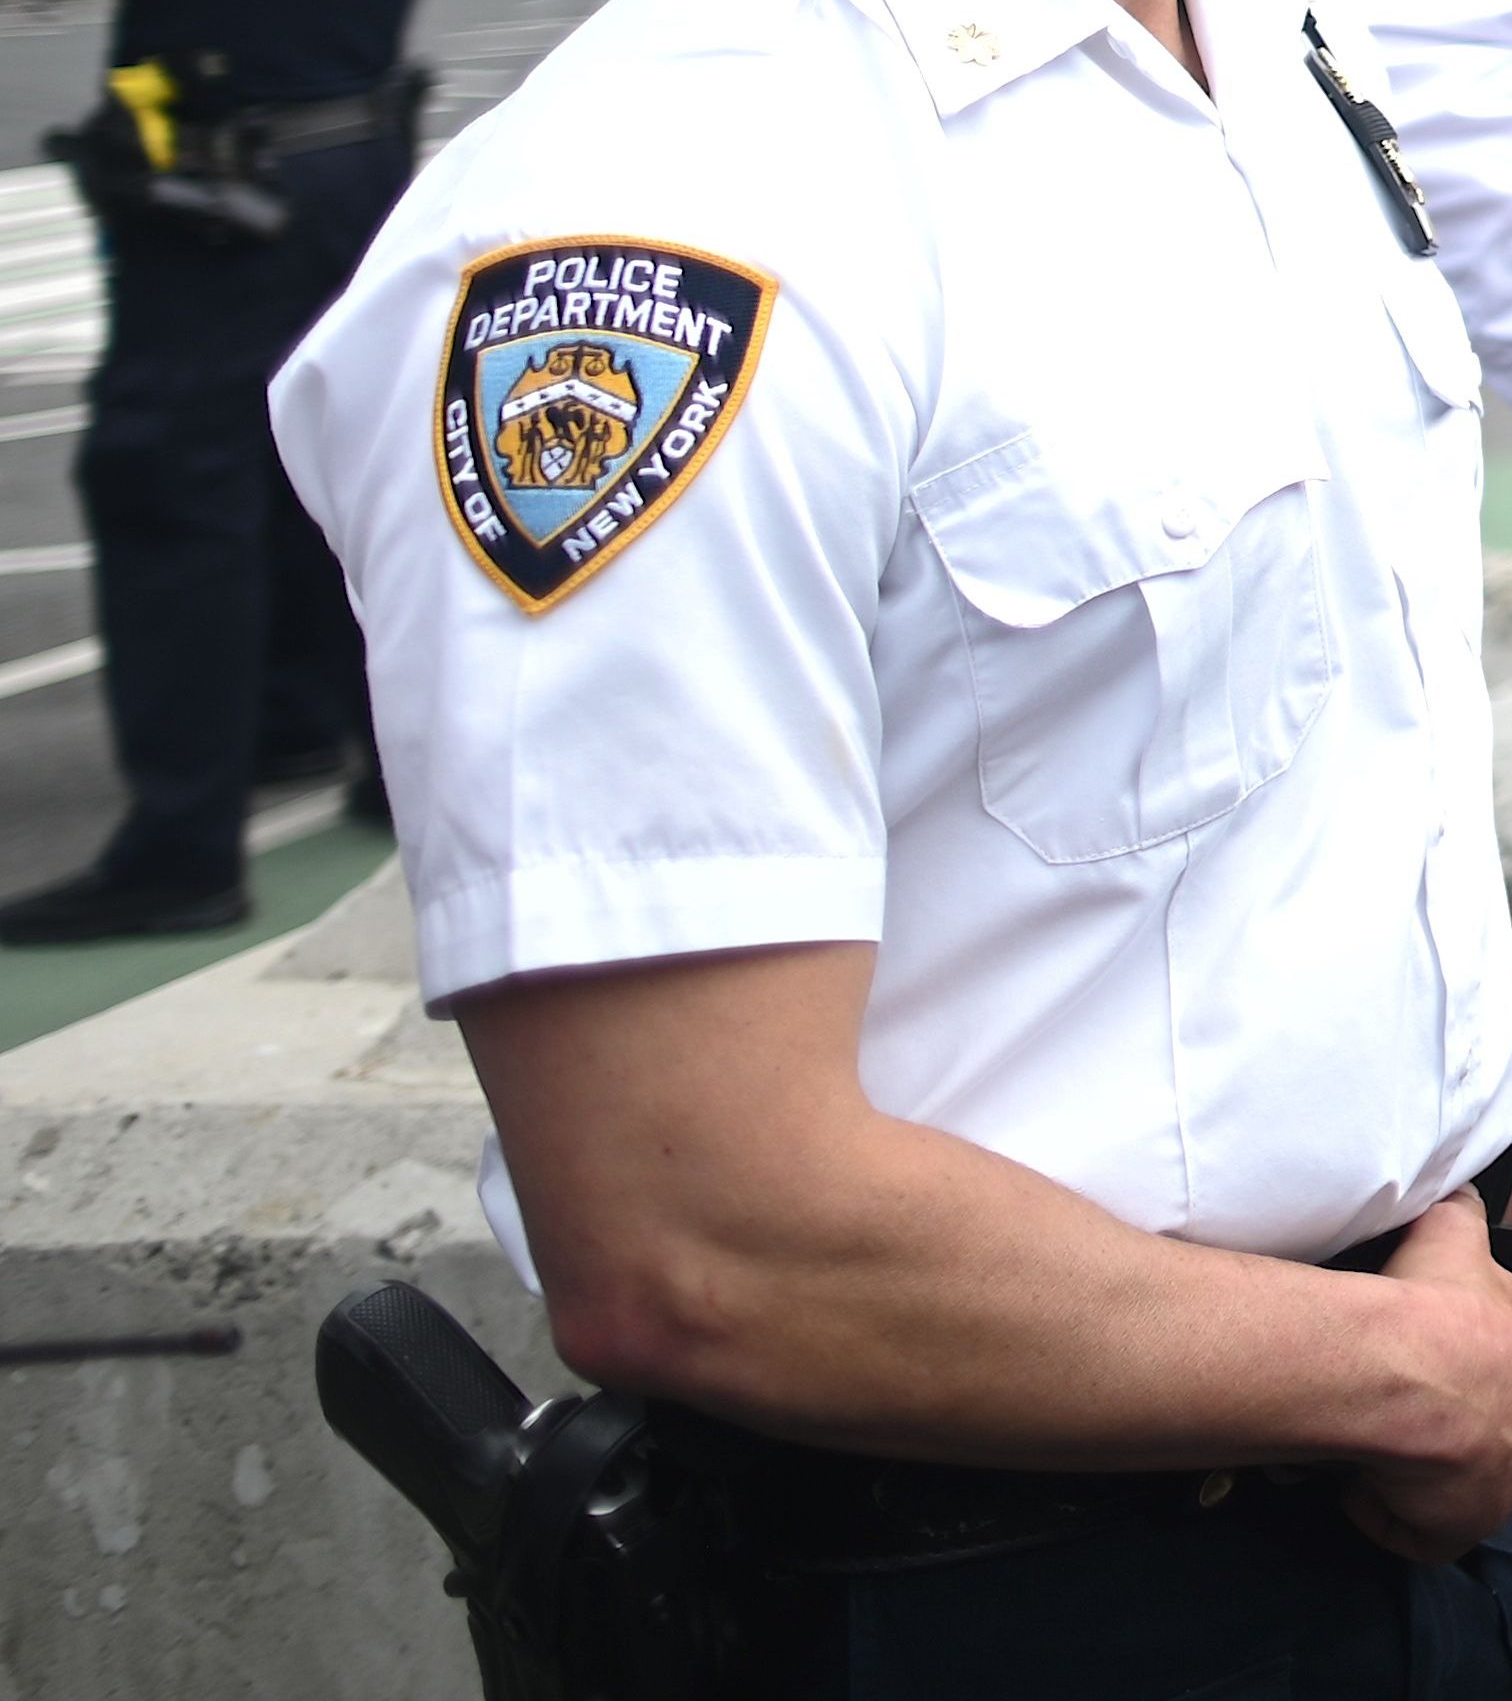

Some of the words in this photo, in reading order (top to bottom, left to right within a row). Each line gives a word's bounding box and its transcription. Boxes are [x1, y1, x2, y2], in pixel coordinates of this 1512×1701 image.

[523, 255, 683, 299] POLICE
[463, 292, 733, 357] DEPARTMENT
[446, 398, 480, 487] CITY
[560, 479, 645, 563] NEW
[637, 379, 729, 482] YORK
[462, 490, 508, 543] OF
